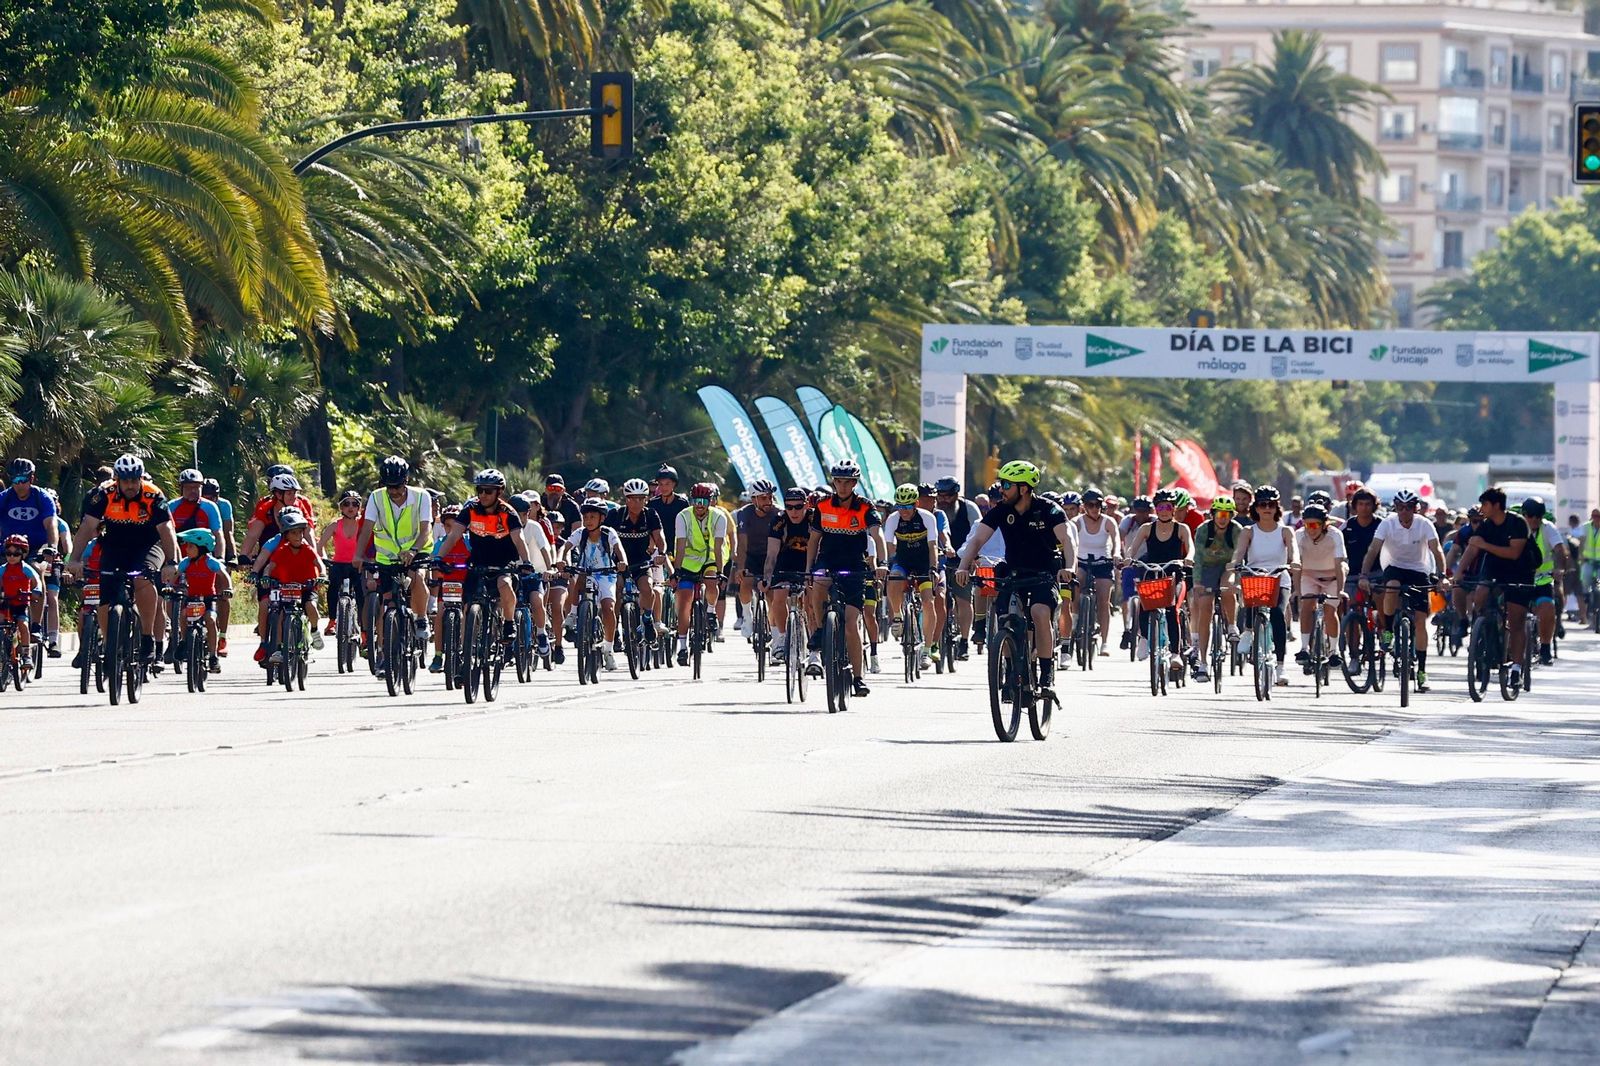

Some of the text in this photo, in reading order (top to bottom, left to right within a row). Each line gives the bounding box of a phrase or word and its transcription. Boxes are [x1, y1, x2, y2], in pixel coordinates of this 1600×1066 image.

[952, 338, 1003, 348] Fundación
[1170, 330, 1353, 354] DÍA DE LA BICI
[952, 348, 989, 358] Unicaja
[1198, 357, 1247, 373] málaga
[1391, 355, 1429, 366] Unicaja
